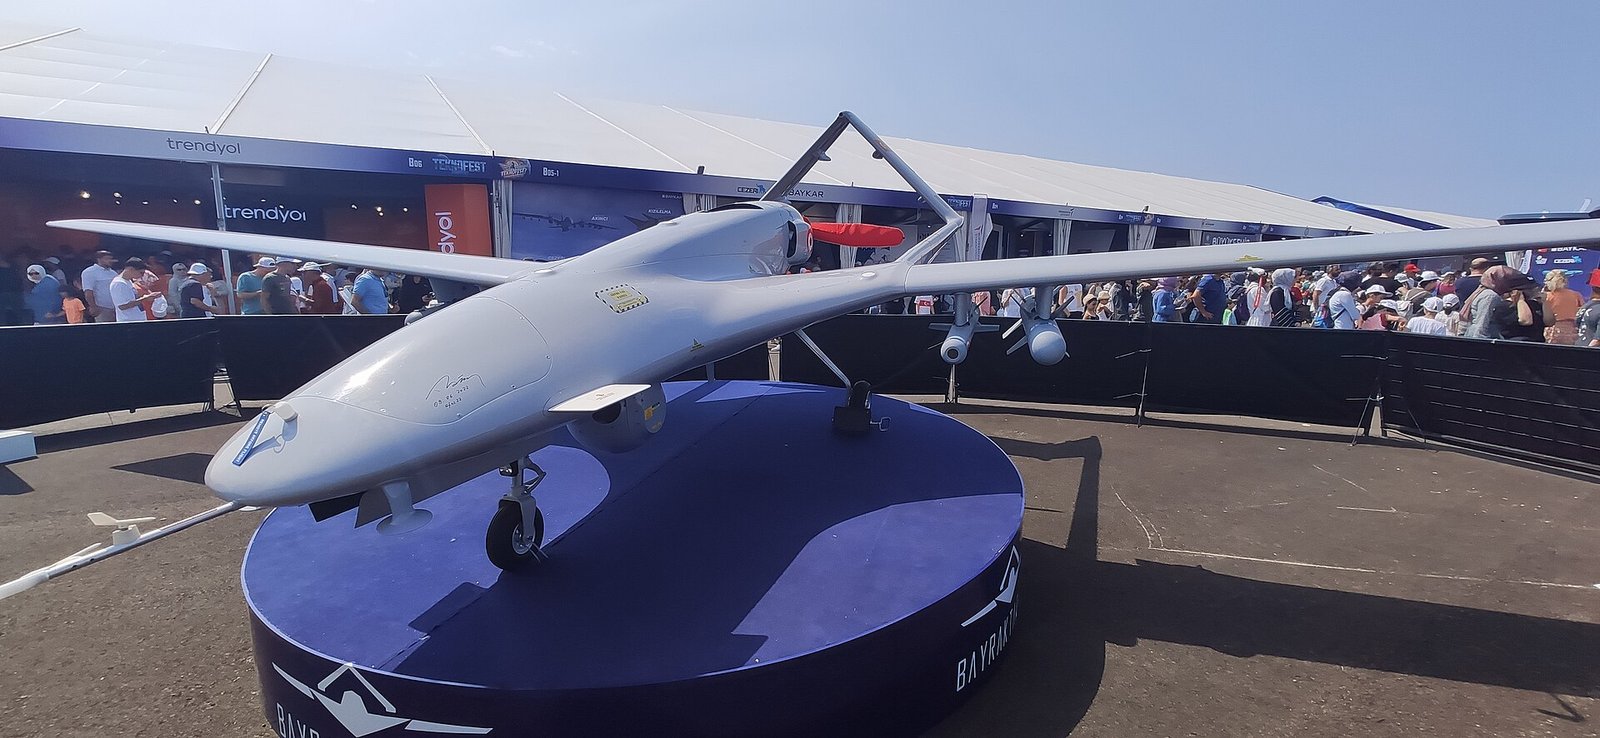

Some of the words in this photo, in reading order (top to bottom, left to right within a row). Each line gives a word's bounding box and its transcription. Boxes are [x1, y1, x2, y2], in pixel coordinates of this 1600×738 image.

[166, 137, 241, 155] trendyol
[789, 189, 824, 198] BAYKAR
[223, 204, 307, 223] trendyol
